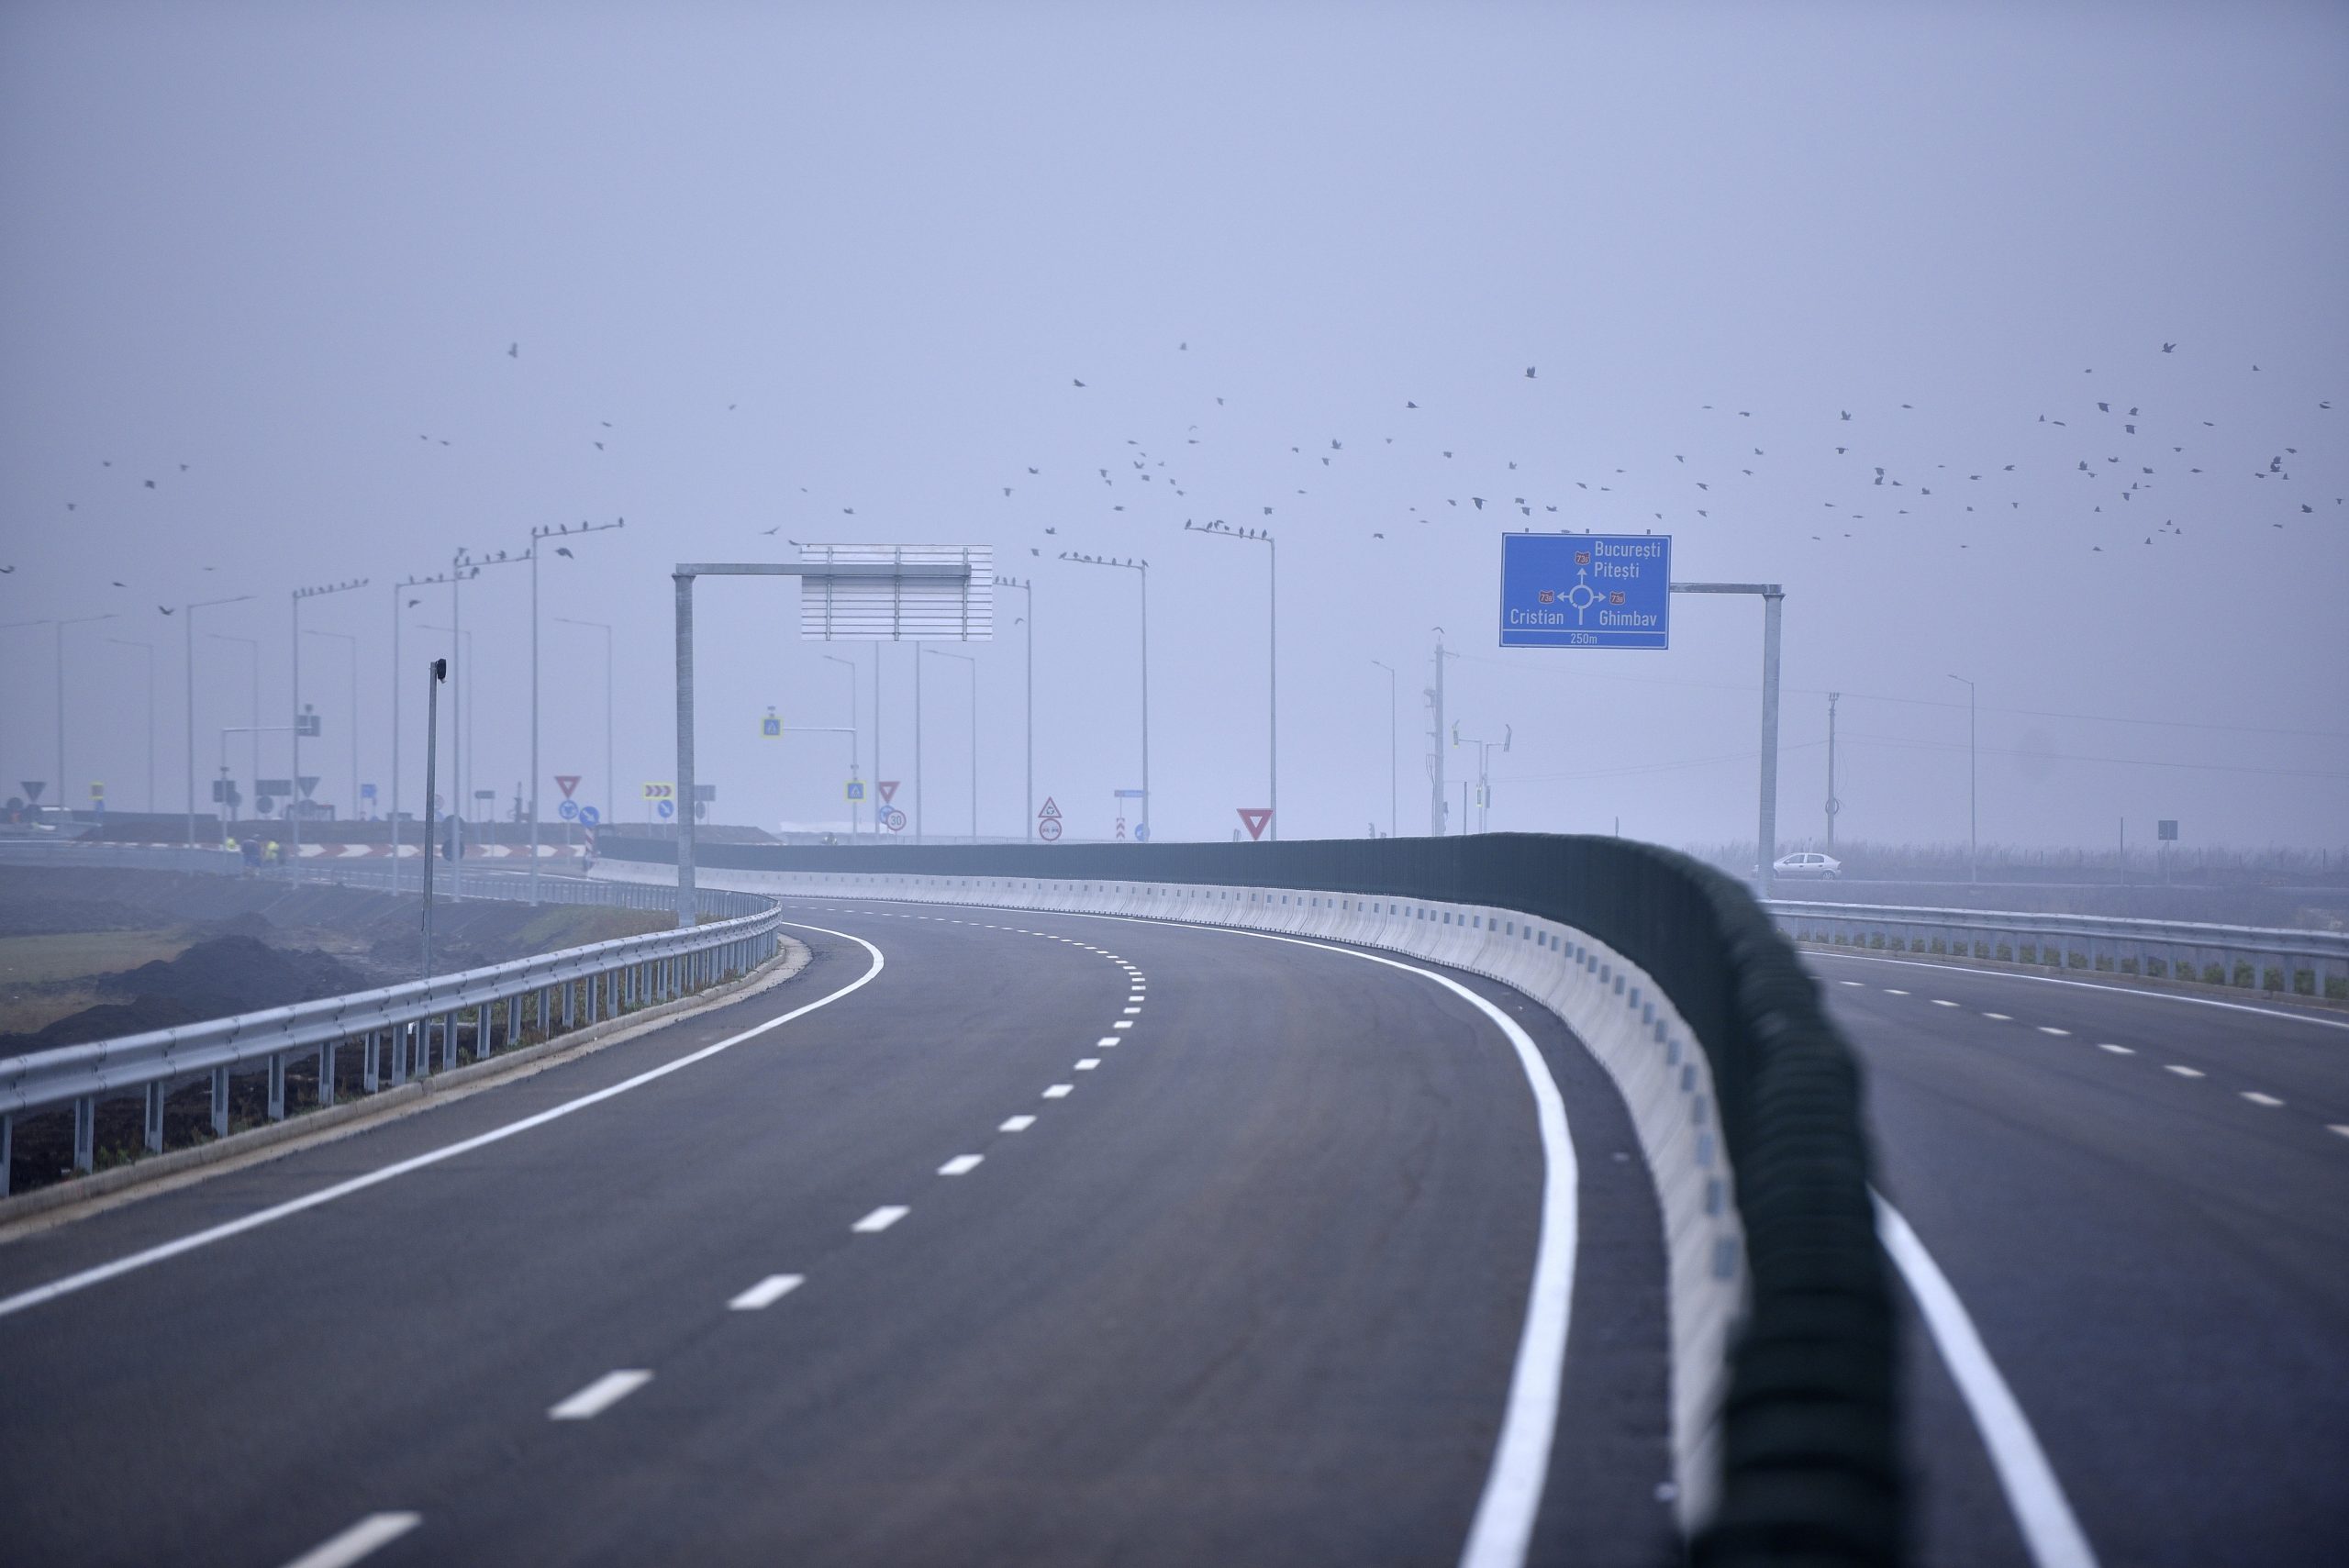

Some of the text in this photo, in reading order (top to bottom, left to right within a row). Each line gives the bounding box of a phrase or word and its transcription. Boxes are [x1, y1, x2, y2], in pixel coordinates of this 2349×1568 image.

[1595, 541, 1661, 559] București
[1594, 562, 1640, 579] Pitești
[1510, 608, 1564, 625] Cristian
[1599, 610, 1657, 627] Ghimbav
[1570, 633, 1598, 644] 250m
[891, 816, 902, 826] 30
